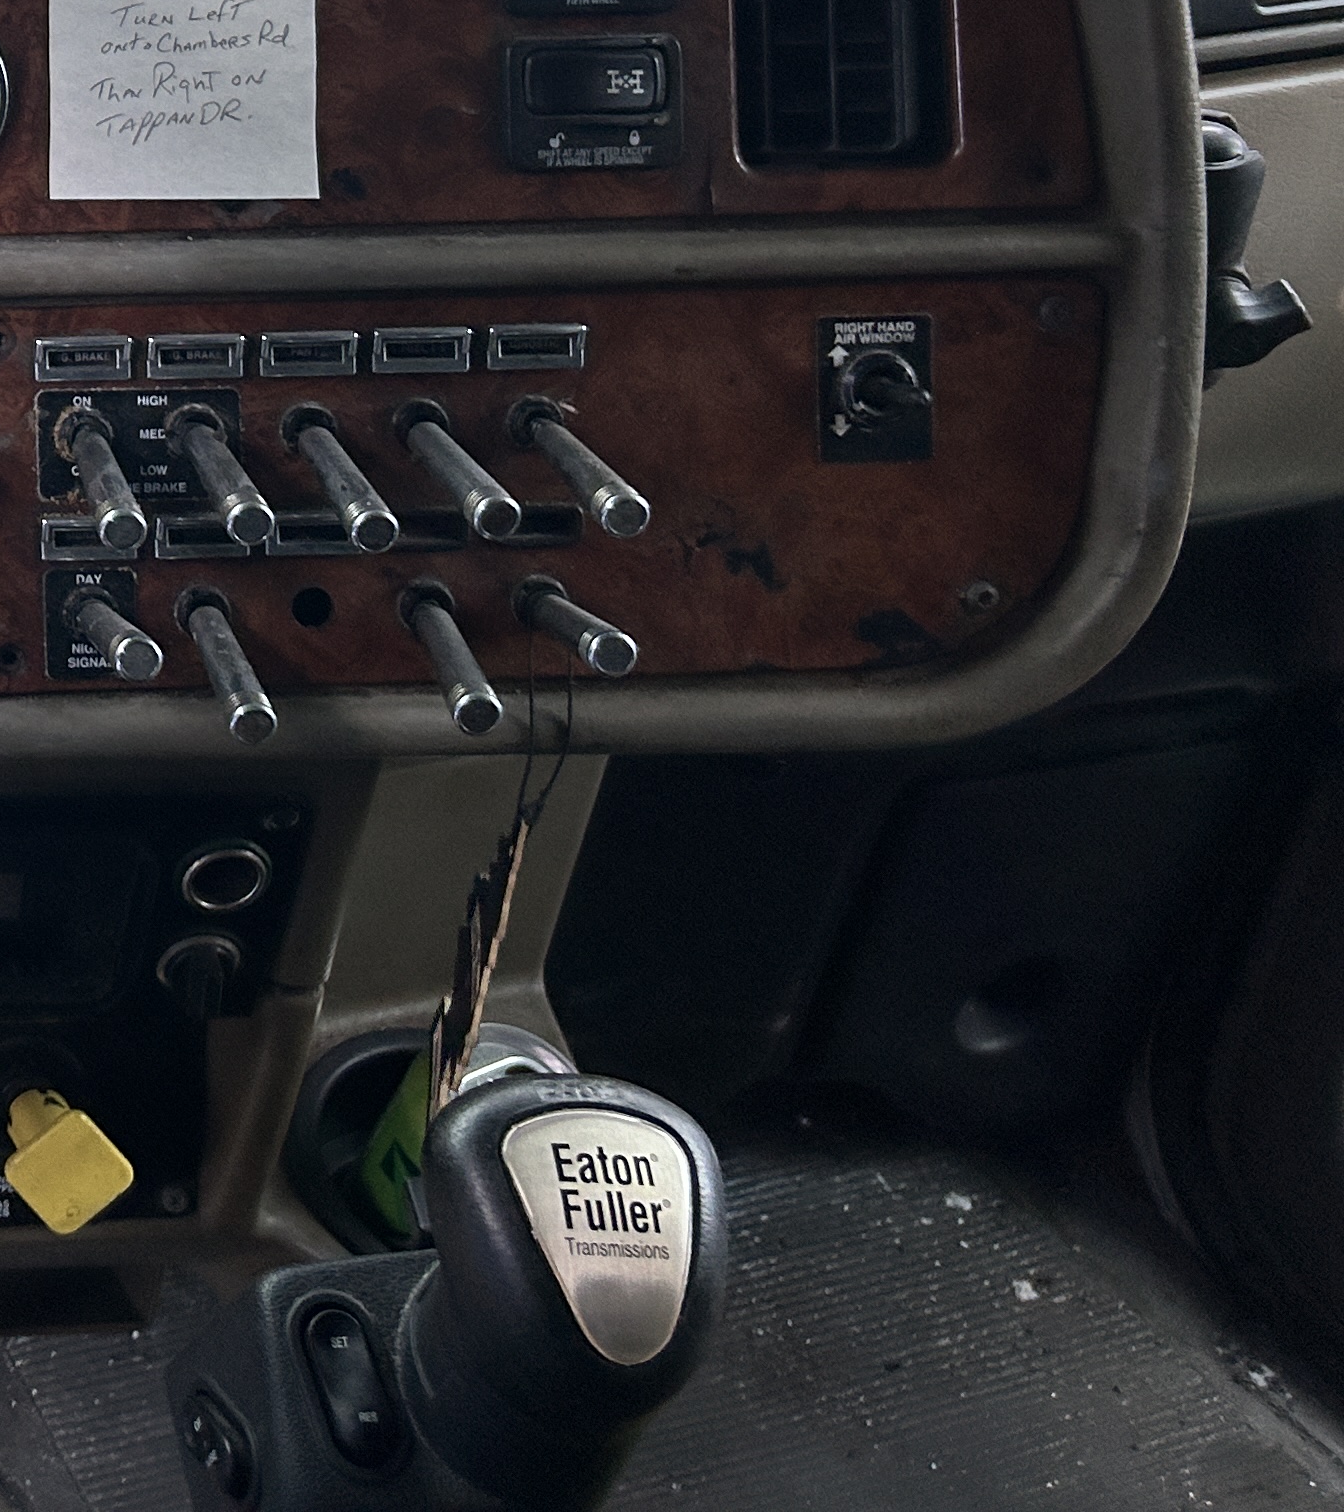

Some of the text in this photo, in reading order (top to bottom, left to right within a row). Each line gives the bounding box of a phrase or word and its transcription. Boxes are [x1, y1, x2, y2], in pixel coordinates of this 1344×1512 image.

[257, 19, 290, 46] Rd
[834, 321, 916, 334] RIGHT HAND
[834, 332, 916, 344] AIR WINDOW
[72, 396, 92, 406] ON
[137, 395, 168, 406] HIGH
[140, 465, 168, 476] LOW
[144, 482, 187, 493] BRAKE
[76, 574, 102, 584] DAY
[551, 1143, 655, 1186] Eaton
[560, 1189, 663, 1234] Fuller
[564, 1237, 670, 1260] Transmissions
[330, 1336, 348, 1348] SET
